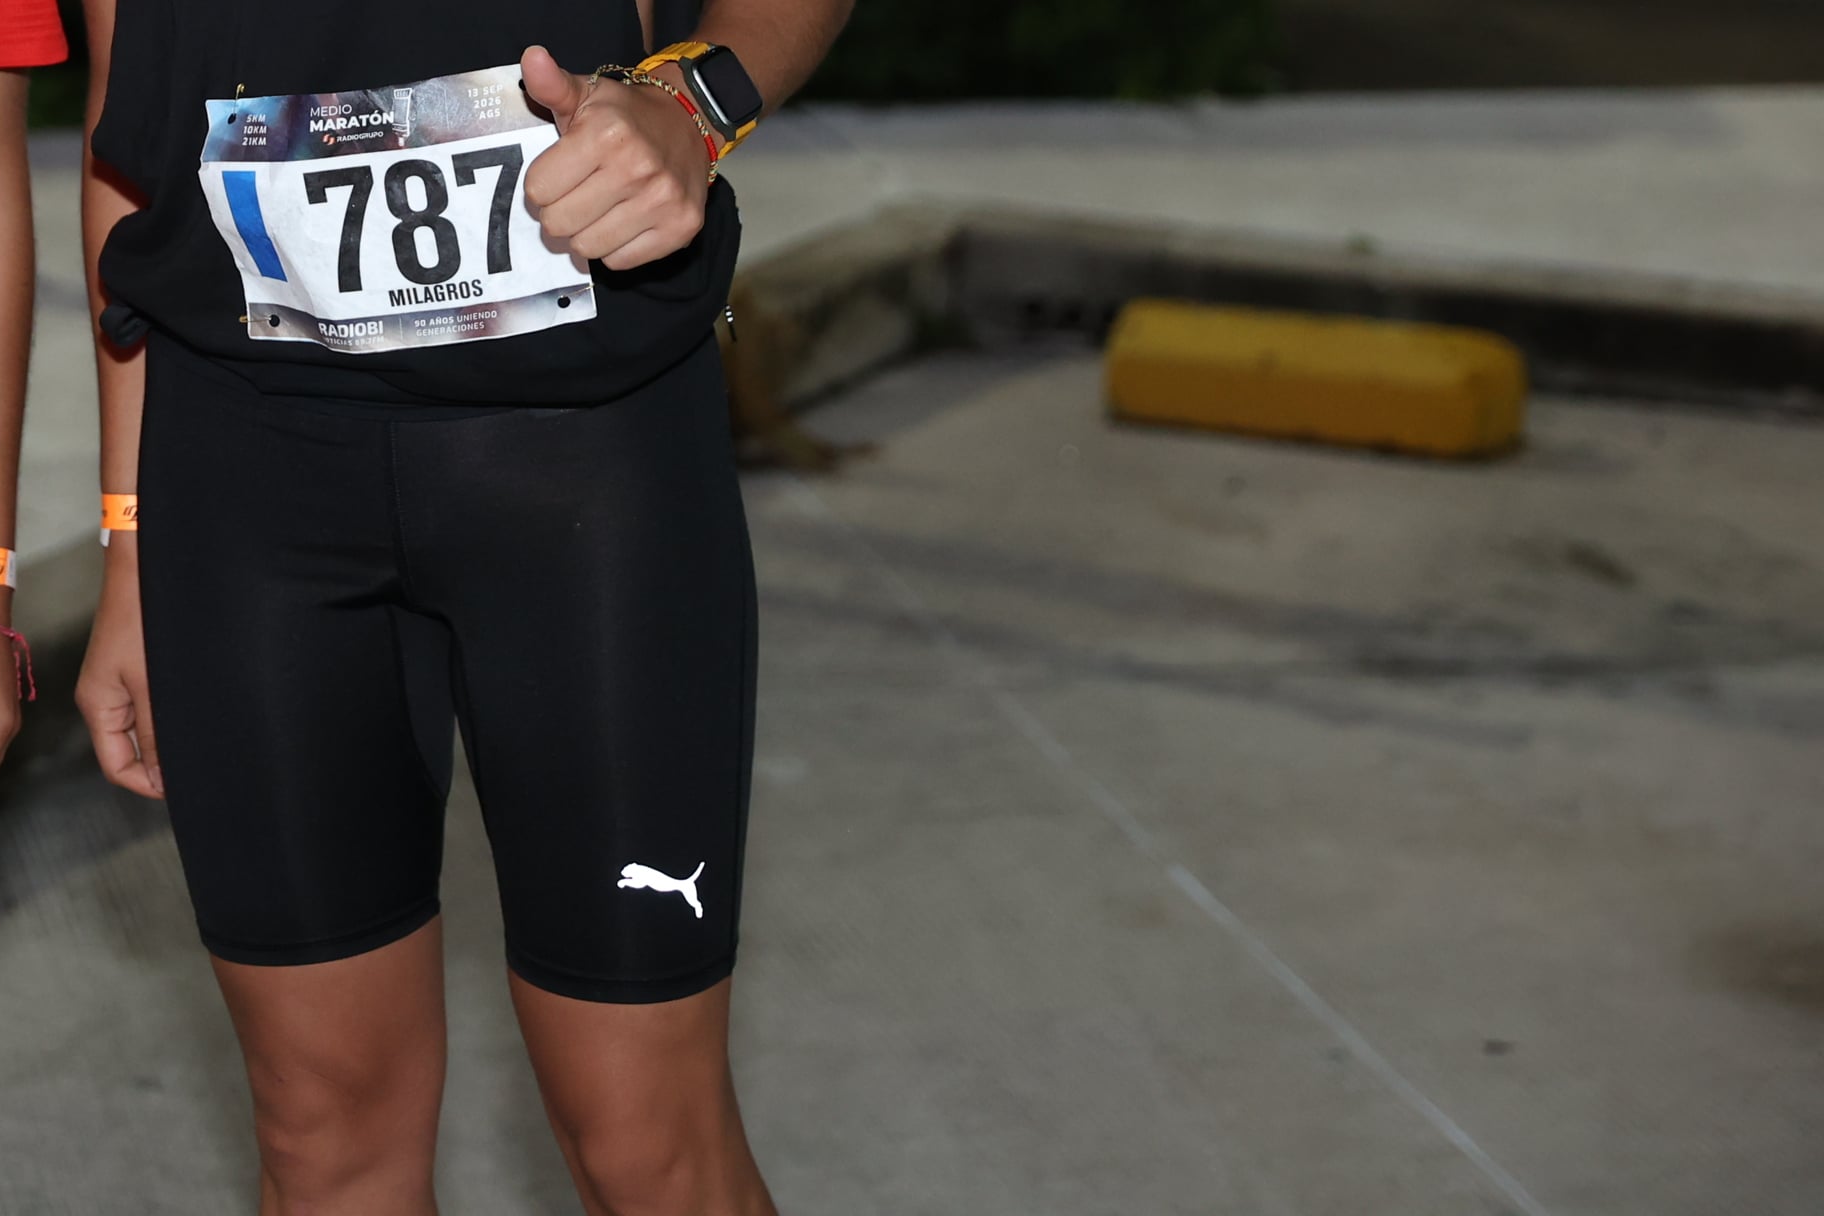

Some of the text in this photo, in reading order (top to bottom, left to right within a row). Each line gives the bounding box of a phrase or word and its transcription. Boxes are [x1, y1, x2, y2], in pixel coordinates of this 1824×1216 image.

[473, 97, 502, 109] 2026
[310, 104, 352, 117] MEDIO
[479, 108, 501, 120] AGS
[246, 113, 266, 123] 5KM
[309, 110, 395, 133] MARATÓN
[243, 125, 267, 135] 10KM
[242, 136, 267, 146] 21KM
[336, 131, 384, 143] RADIOGRUPO
[302, 143, 525, 293] 787
[388, 279, 484, 307] MILAGROS
[414, 310, 498, 327] 90 AÑOS UNIENDO
[318, 320, 384, 338] RADIOBI
[416, 322, 485, 337] GENERACIONES
